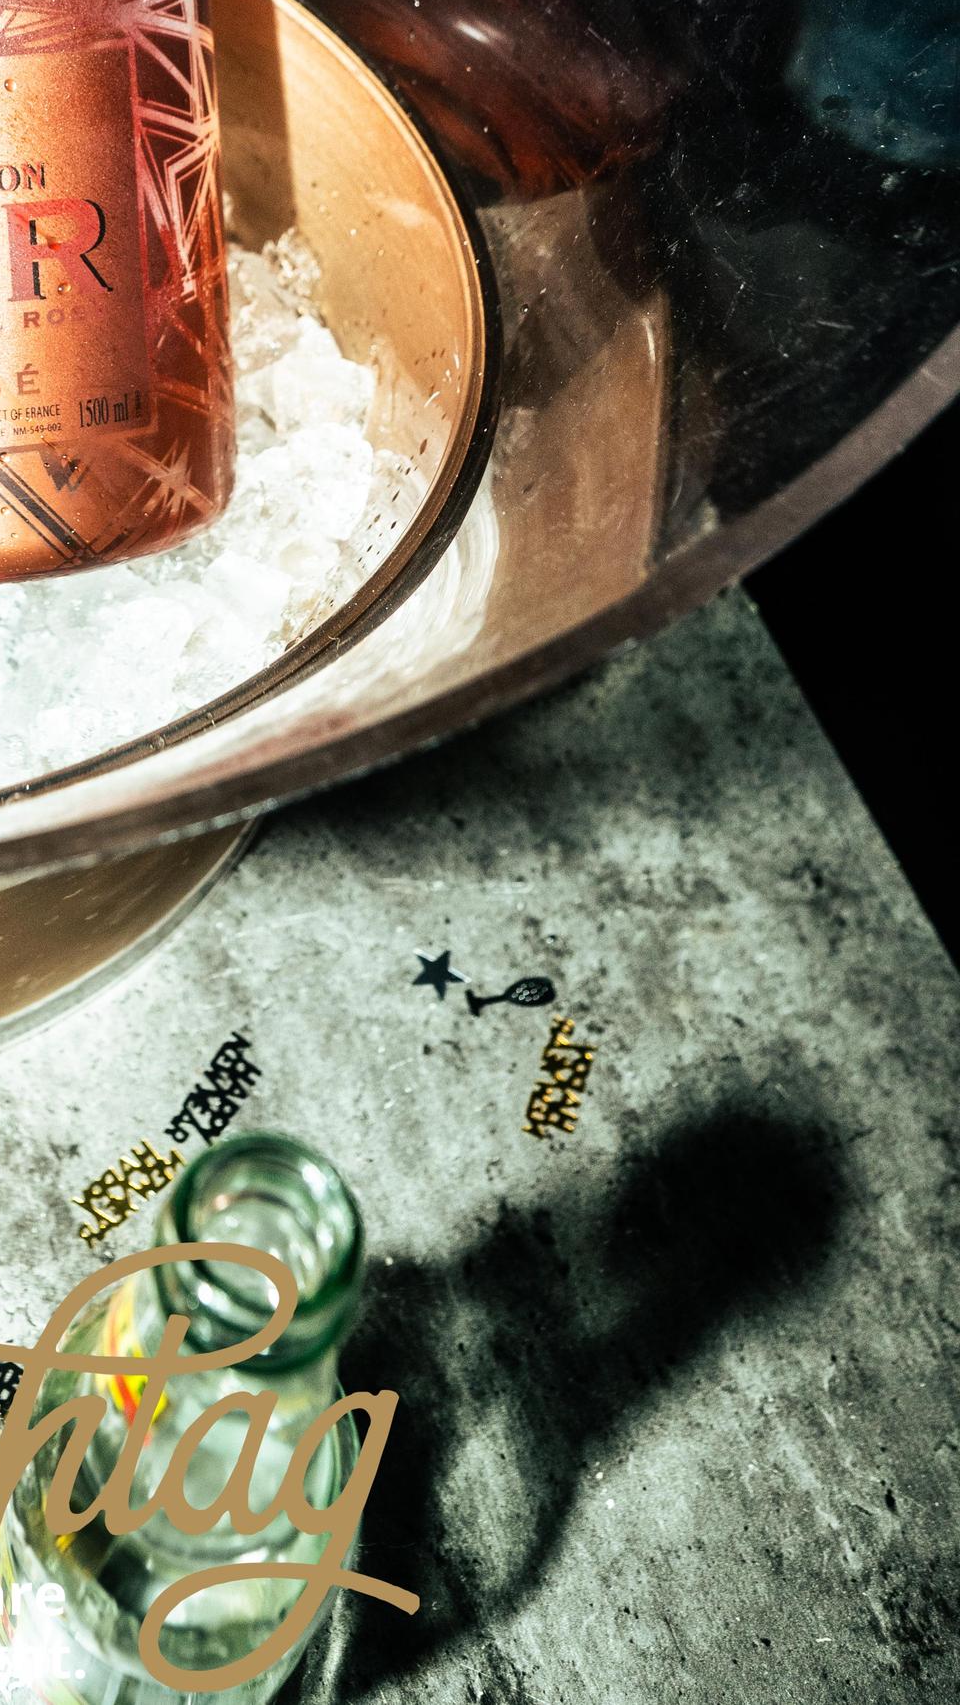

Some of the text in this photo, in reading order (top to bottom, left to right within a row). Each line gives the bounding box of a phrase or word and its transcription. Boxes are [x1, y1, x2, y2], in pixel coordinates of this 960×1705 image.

[10, 408, 23, 421] OF
[25, 403, 61, 420] FRANCE
[78, 395, 109, 428] 1500
